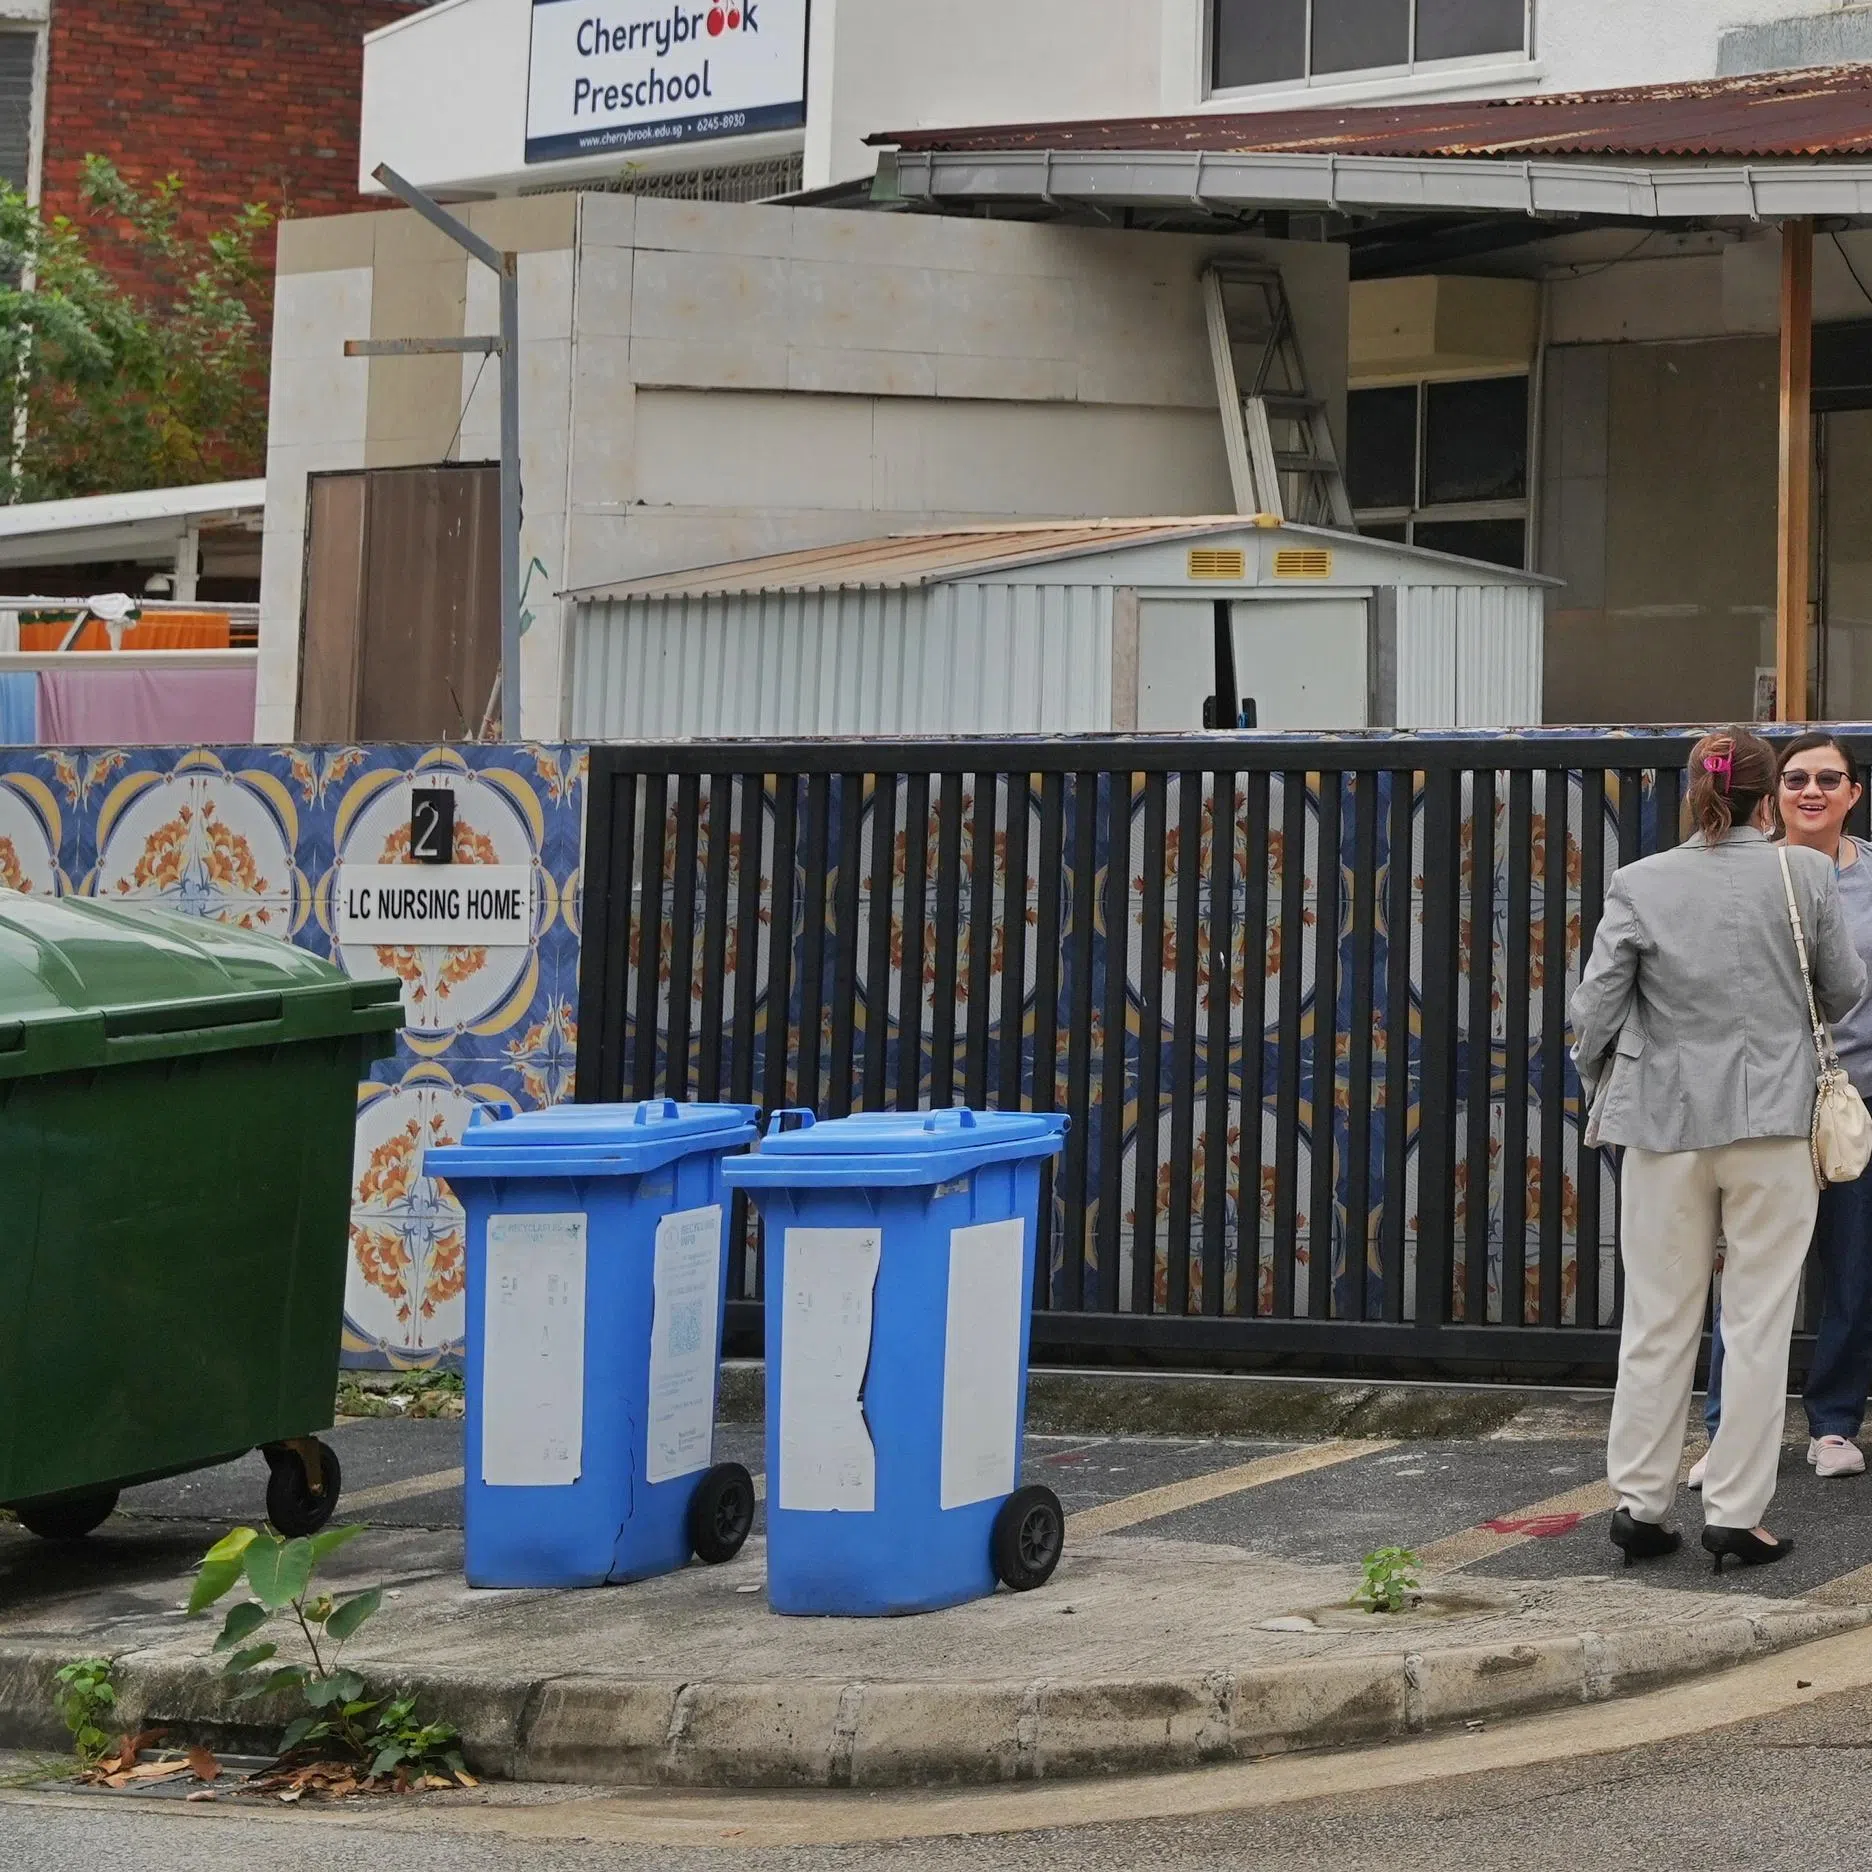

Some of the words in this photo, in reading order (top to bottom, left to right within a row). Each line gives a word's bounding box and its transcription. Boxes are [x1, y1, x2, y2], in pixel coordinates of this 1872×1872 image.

[573, 59, 712, 116] Preschool
[579, 124, 683, 148] www.cherrybrook.edu.sg
[697, 112, 746, 132] 6245-8930
[414, 800, 440, 857] 2
[349, 888, 371, 920] LC
[378, 888, 460, 920] NURSING
[467, 888, 521, 920] HOME
